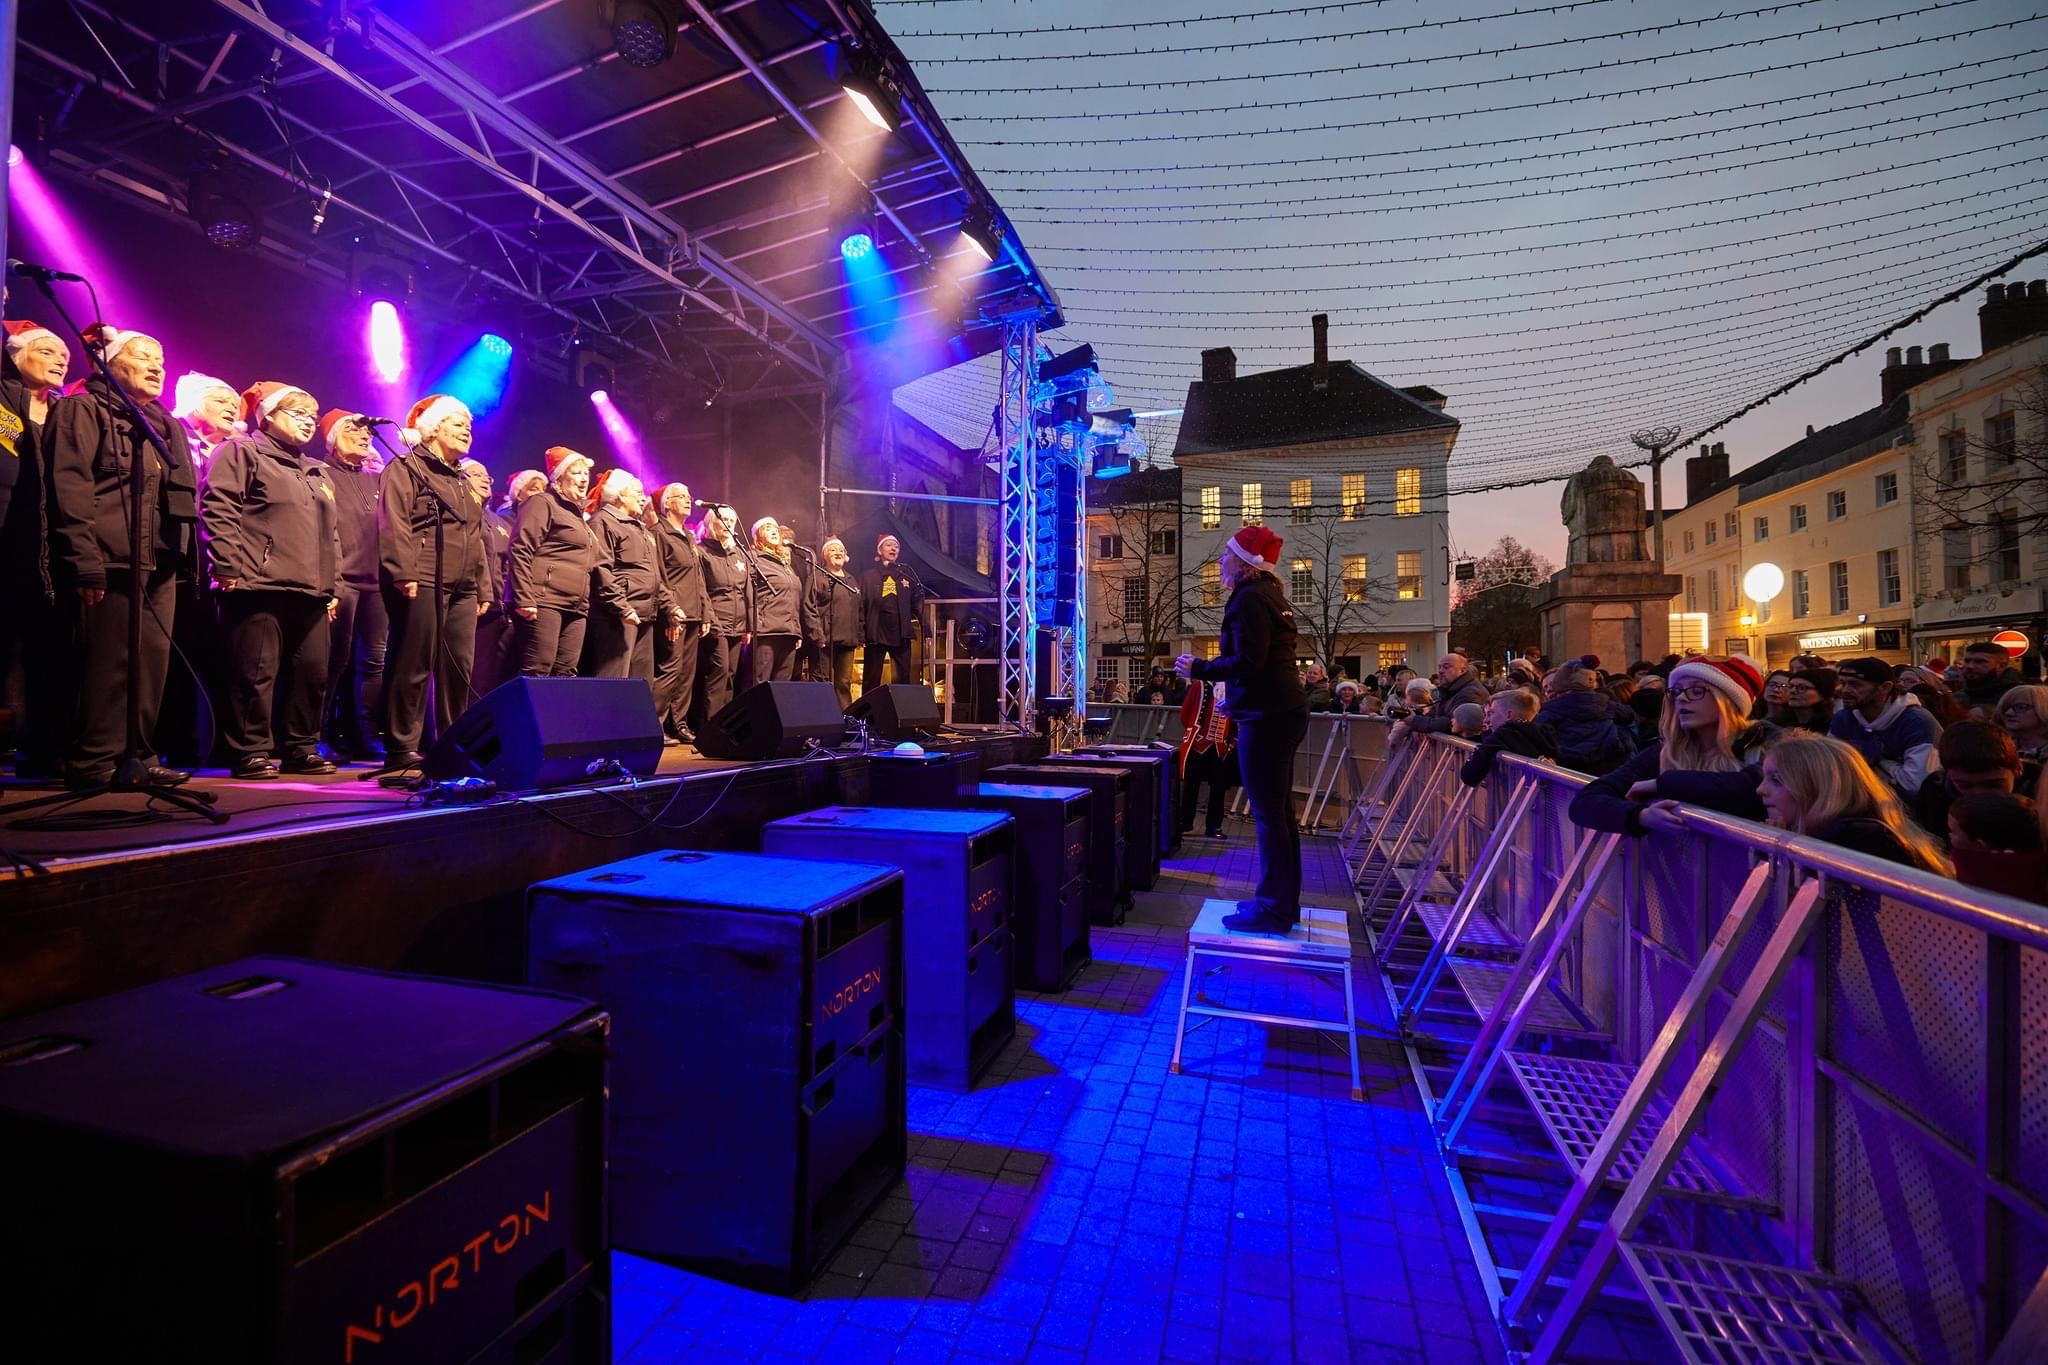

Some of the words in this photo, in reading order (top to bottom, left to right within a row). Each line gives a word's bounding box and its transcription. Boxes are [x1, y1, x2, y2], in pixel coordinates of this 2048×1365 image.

[1799, 633, 1860, 649] WATERSTONES
[822, 967, 881, 1024] NORTON
[345, 1190, 550, 1364] NORTON
